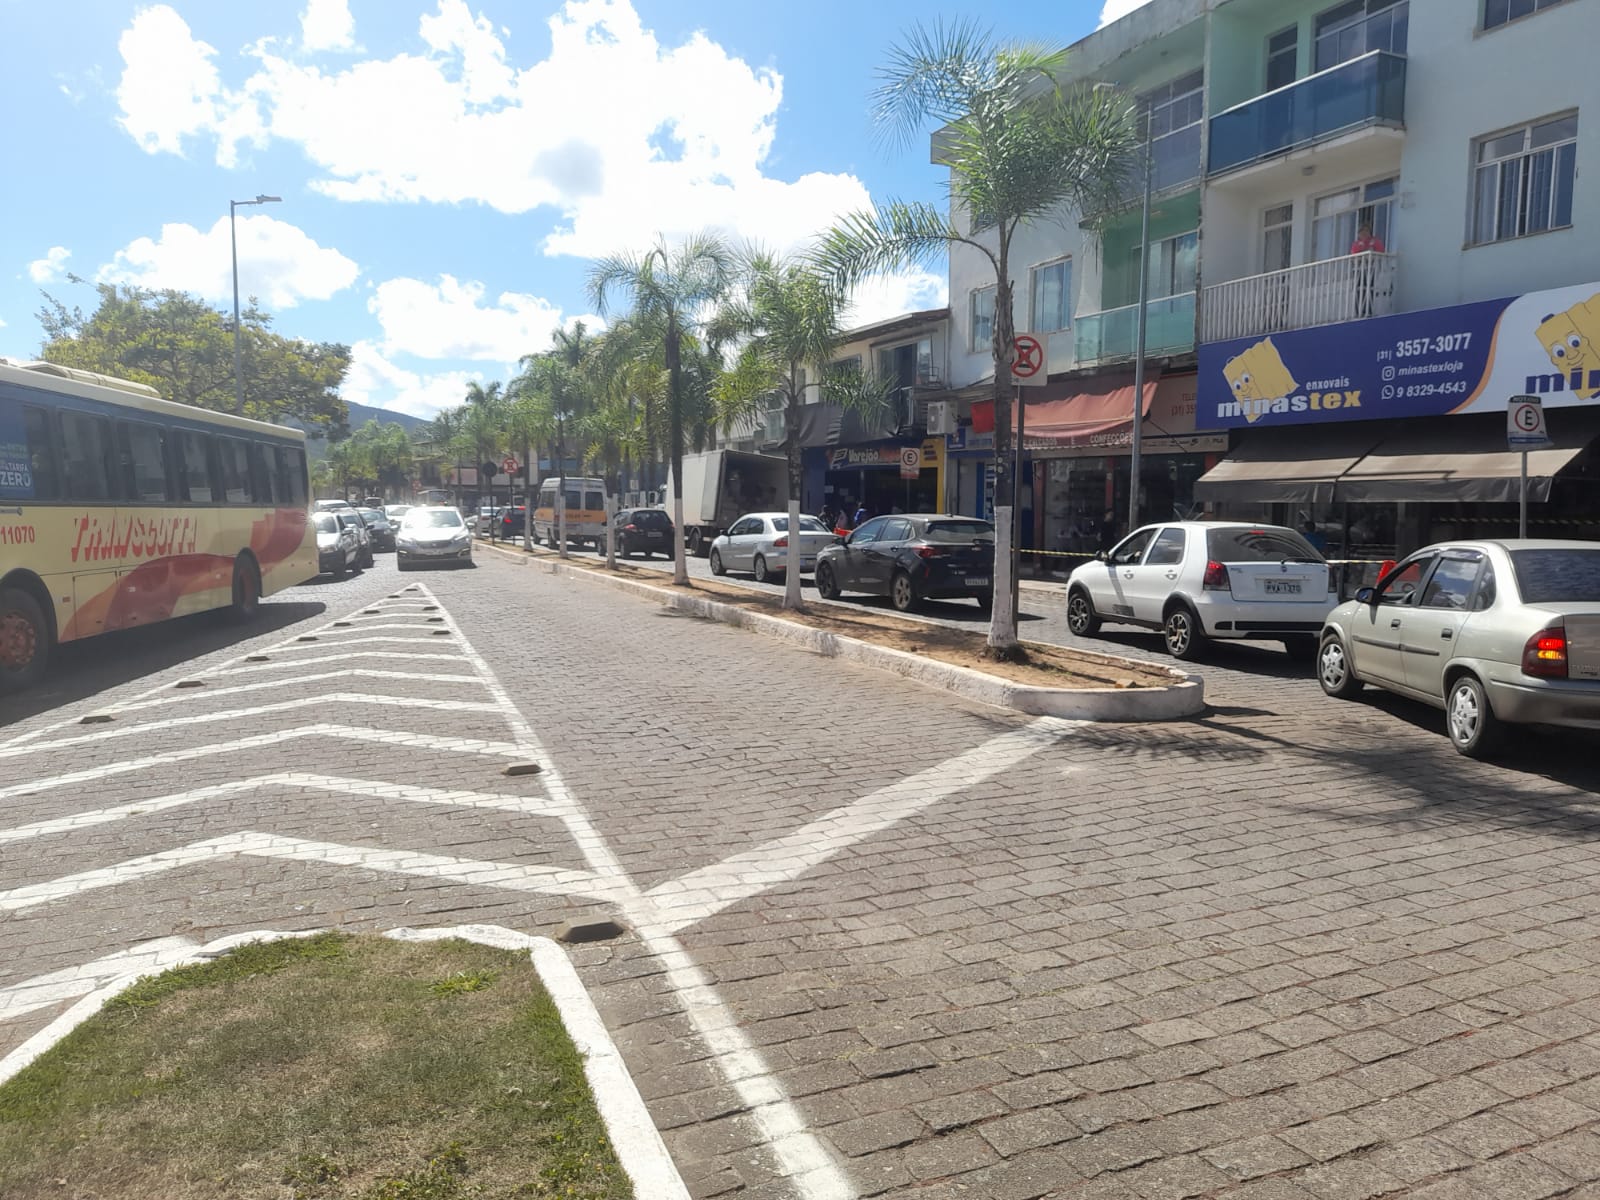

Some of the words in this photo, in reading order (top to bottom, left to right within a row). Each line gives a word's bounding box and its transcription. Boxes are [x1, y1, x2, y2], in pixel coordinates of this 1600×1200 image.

[1396, 332, 1472, 357] 3557-3077
[1398, 361, 1464, 376] minastexloja
[1306, 376, 1350, 390] enxovais
[1396, 387, 1404, 398] 9
[1406, 381, 1467, 397] 8329-4543
[1217, 390, 1361, 418] minastex
[1525, 410, 1533, 426] E
[907, 453, 913, 463] E
[0, 471, 31, 487] ZERO
